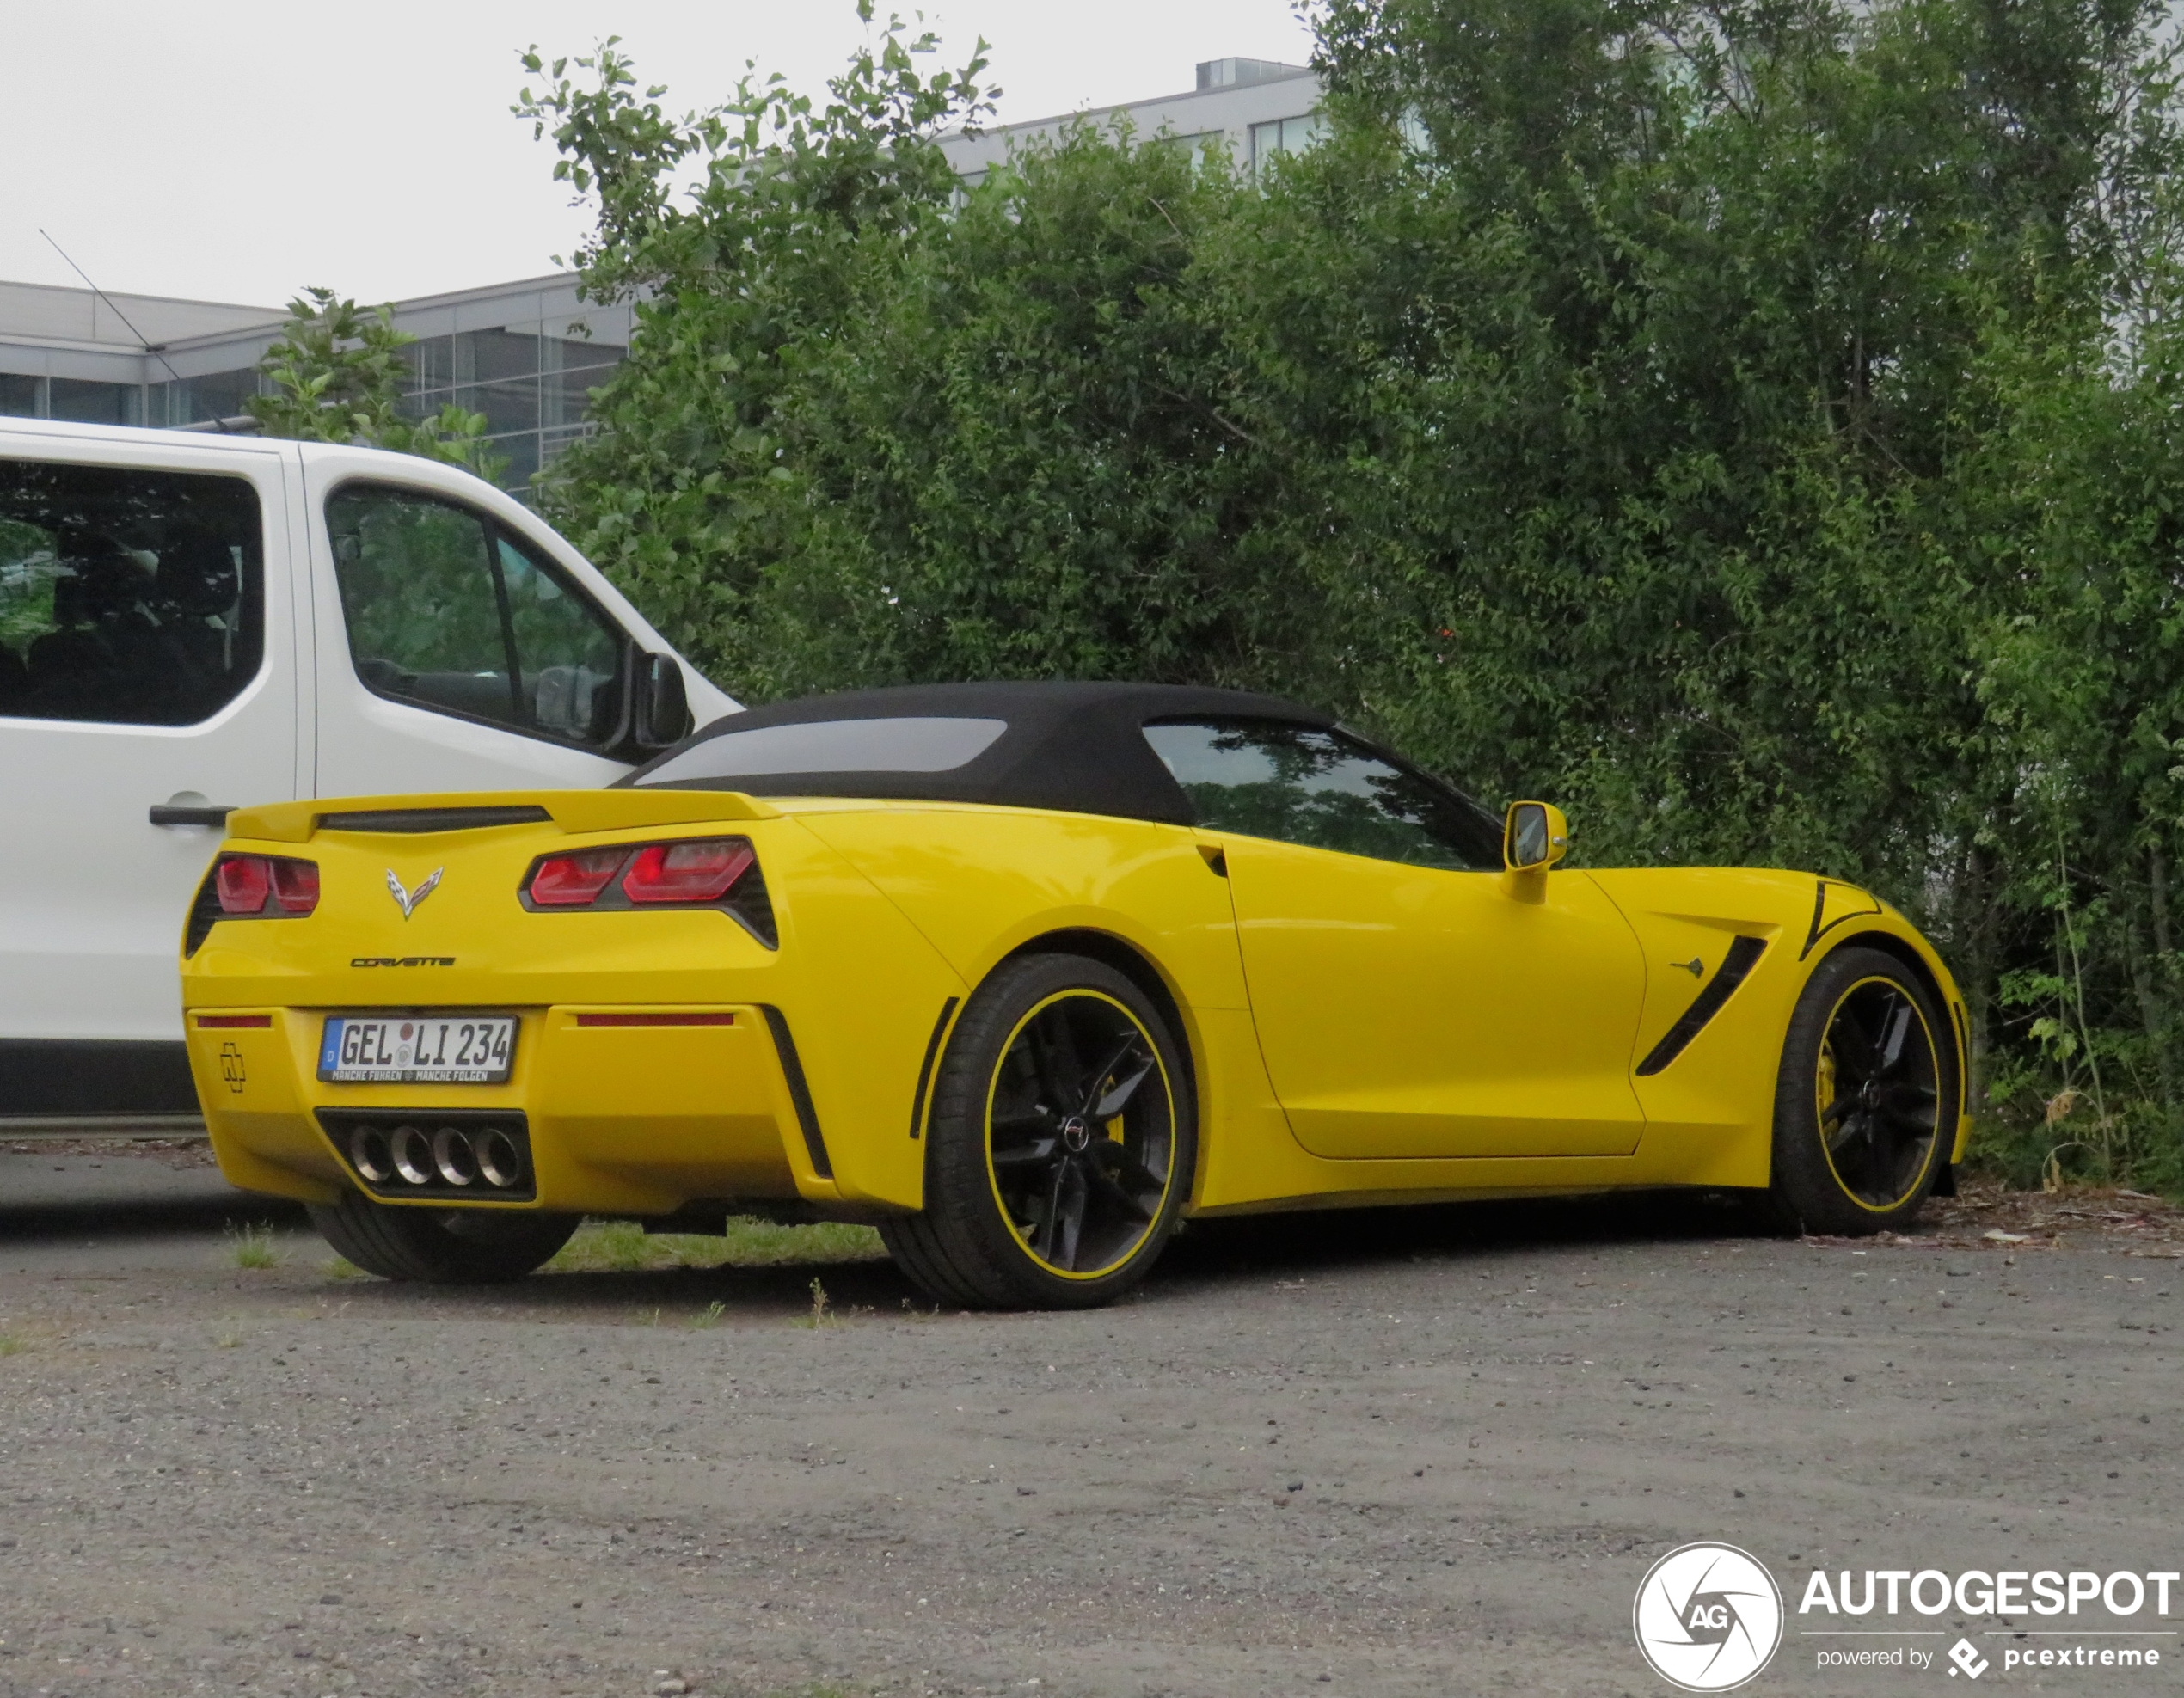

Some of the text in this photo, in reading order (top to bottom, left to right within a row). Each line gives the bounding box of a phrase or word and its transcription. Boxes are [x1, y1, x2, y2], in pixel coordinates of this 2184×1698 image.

[350, 957, 456, 967] CORVETTE
[341, 1023, 507, 1065] GEL LI 234
[332, 1070, 366, 1081] MANCHE
[415, 1070, 451, 1081] MANCHE
[453, 1071, 488, 1082] FOLGEN
